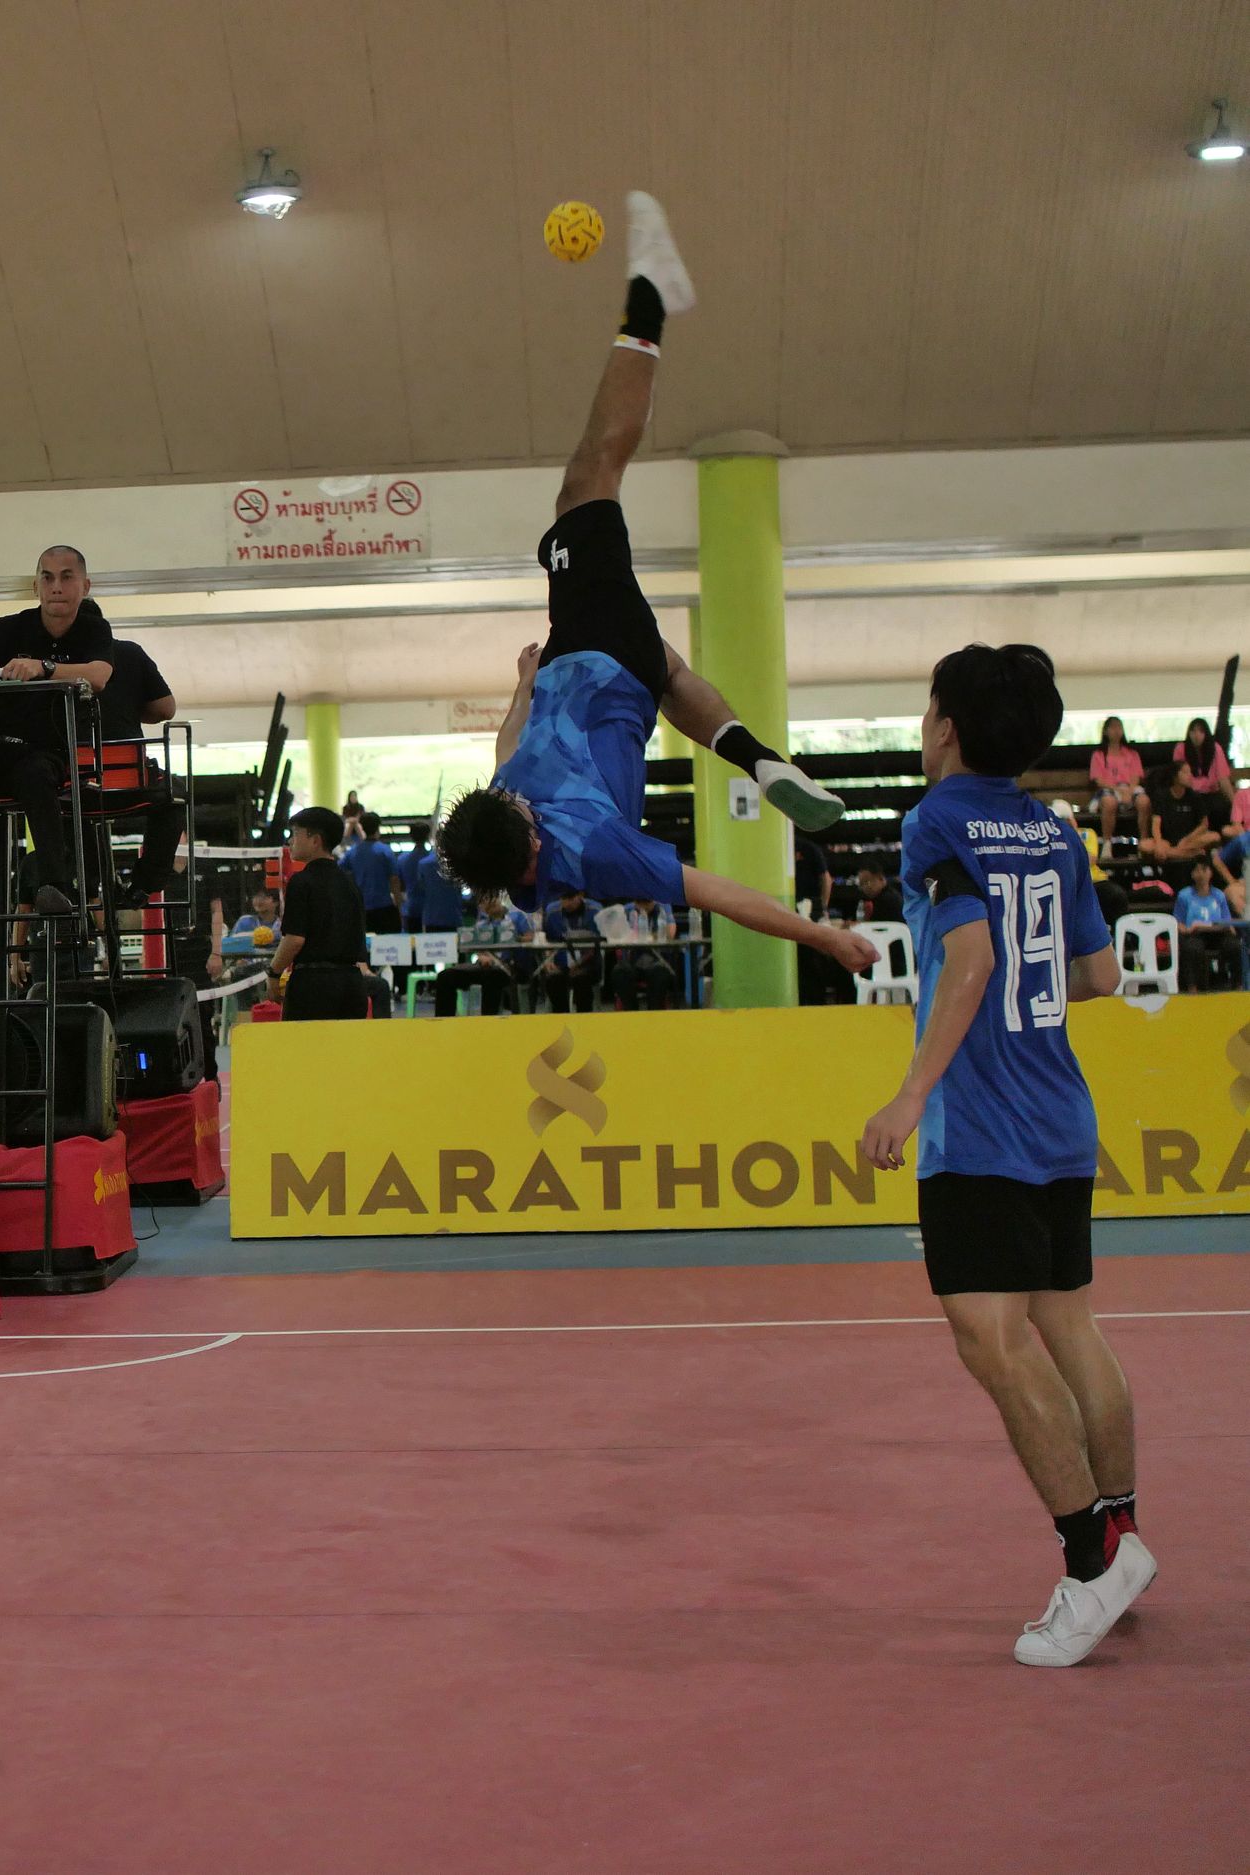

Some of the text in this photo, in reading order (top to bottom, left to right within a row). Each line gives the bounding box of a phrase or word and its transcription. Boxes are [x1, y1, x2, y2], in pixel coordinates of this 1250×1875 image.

[275, 487, 378, 523] ห้ามสูบบุหรี่
[237, 528, 422, 561] ห้ามถอดเสื้อเล่นกีฬา
[987, 868, 1068, 1032] 19
[270, 1140, 876, 1217] MARATHON
